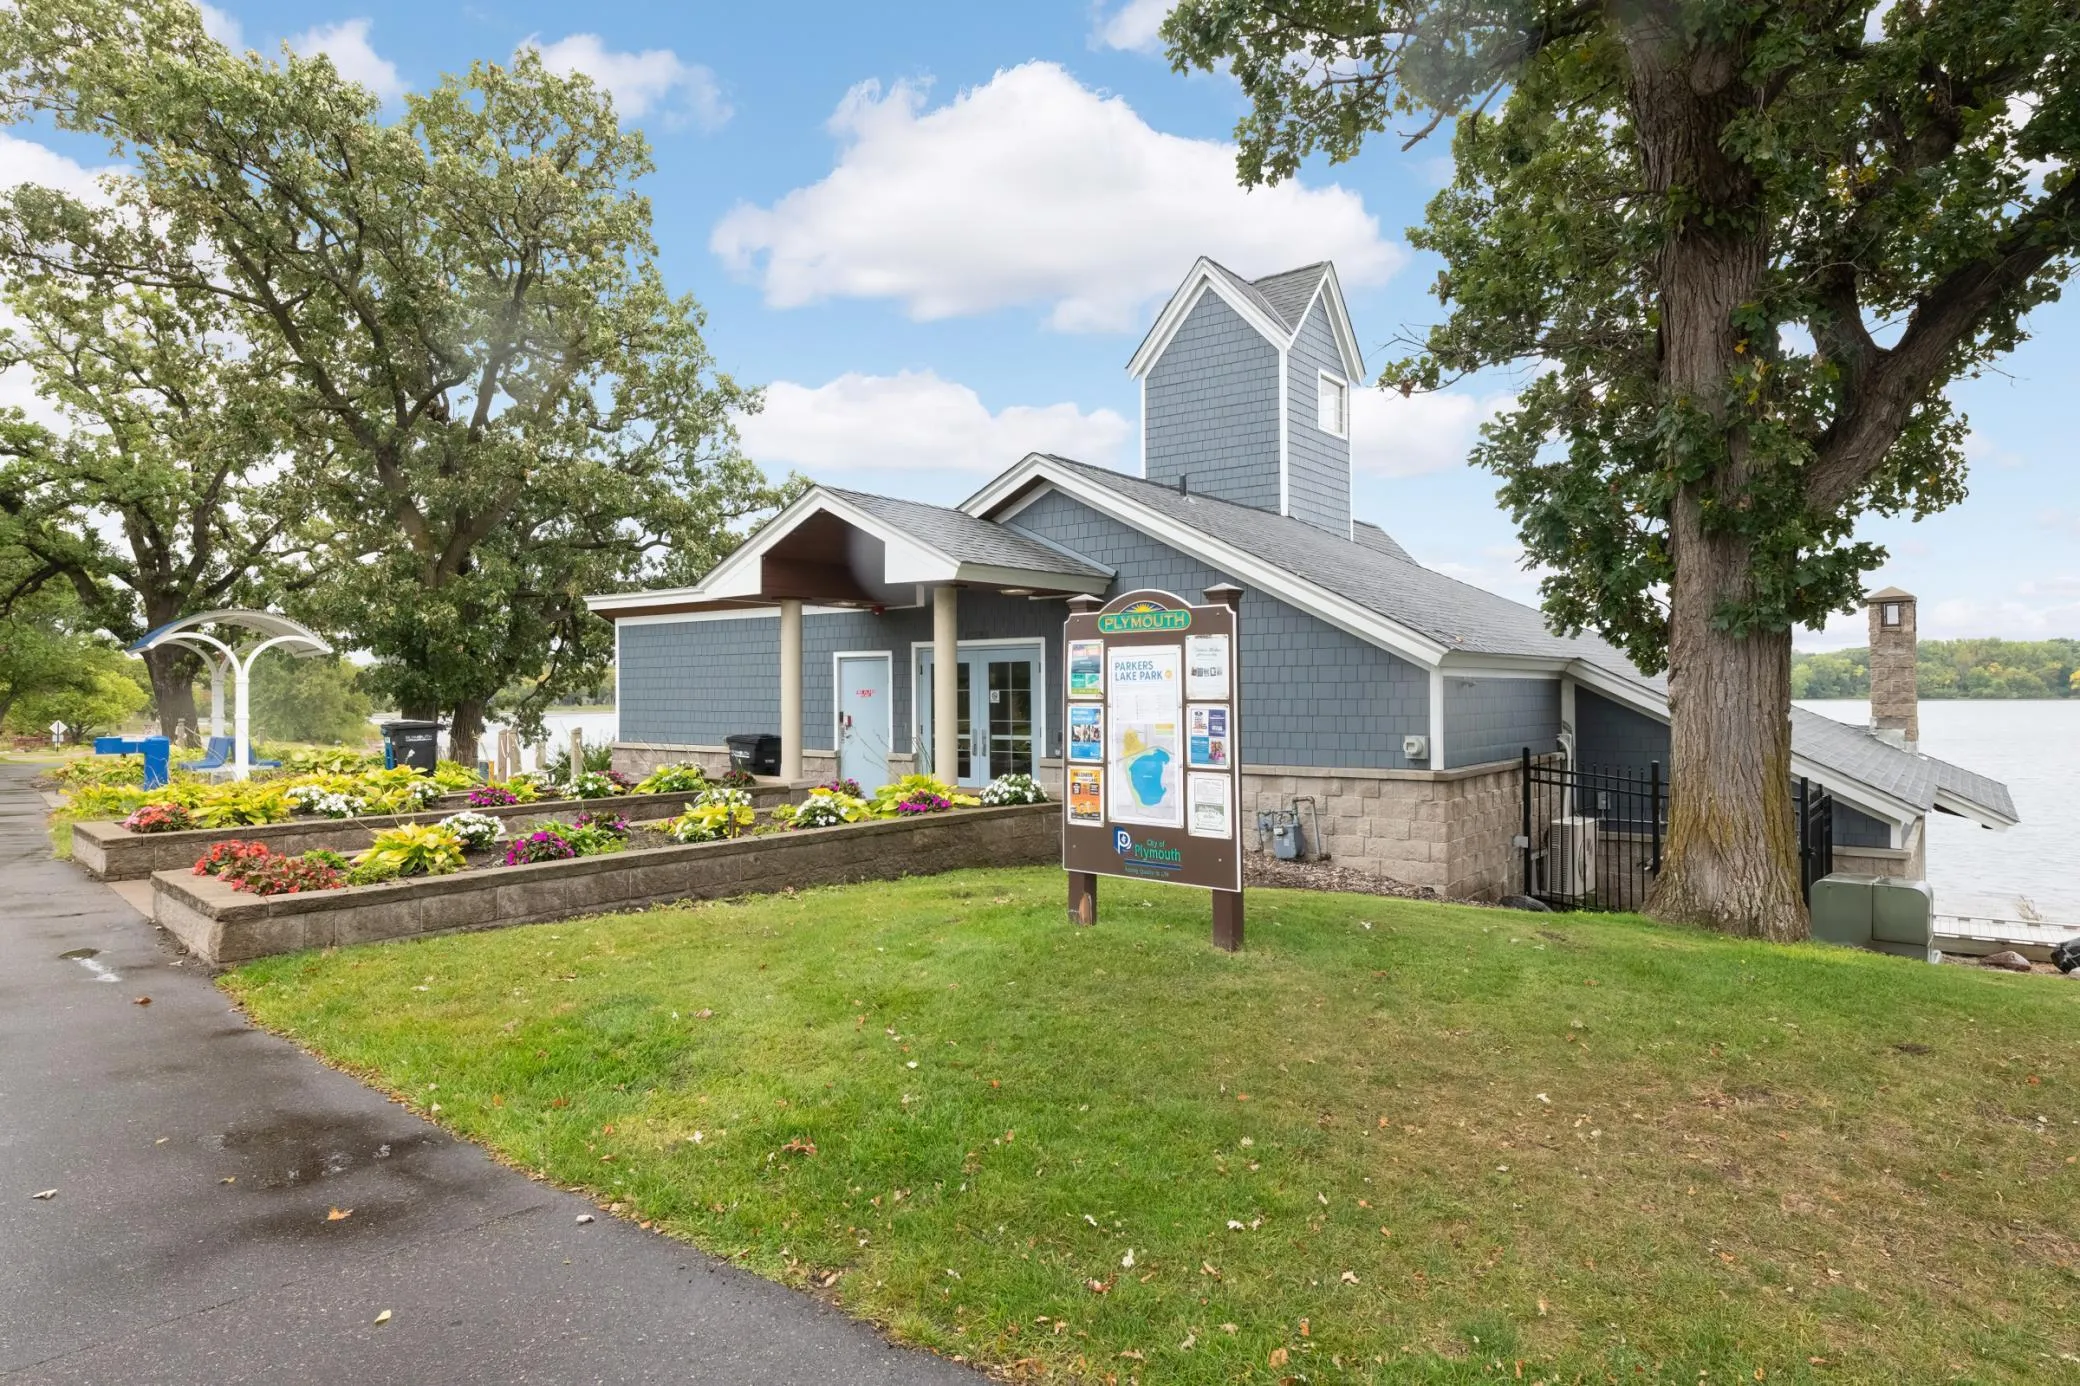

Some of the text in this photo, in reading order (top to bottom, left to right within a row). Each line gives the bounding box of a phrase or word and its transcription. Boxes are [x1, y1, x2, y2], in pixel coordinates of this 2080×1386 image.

[1103, 612, 1185, 631] PLYMOUTH
[1114, 660, 1154, 672] PARKERS
[1115, 670, 1163, 682] LAKE PARK
[1146, 838, 1165, 848] City of
[1134, 843, 1181, 862] Plymouth
